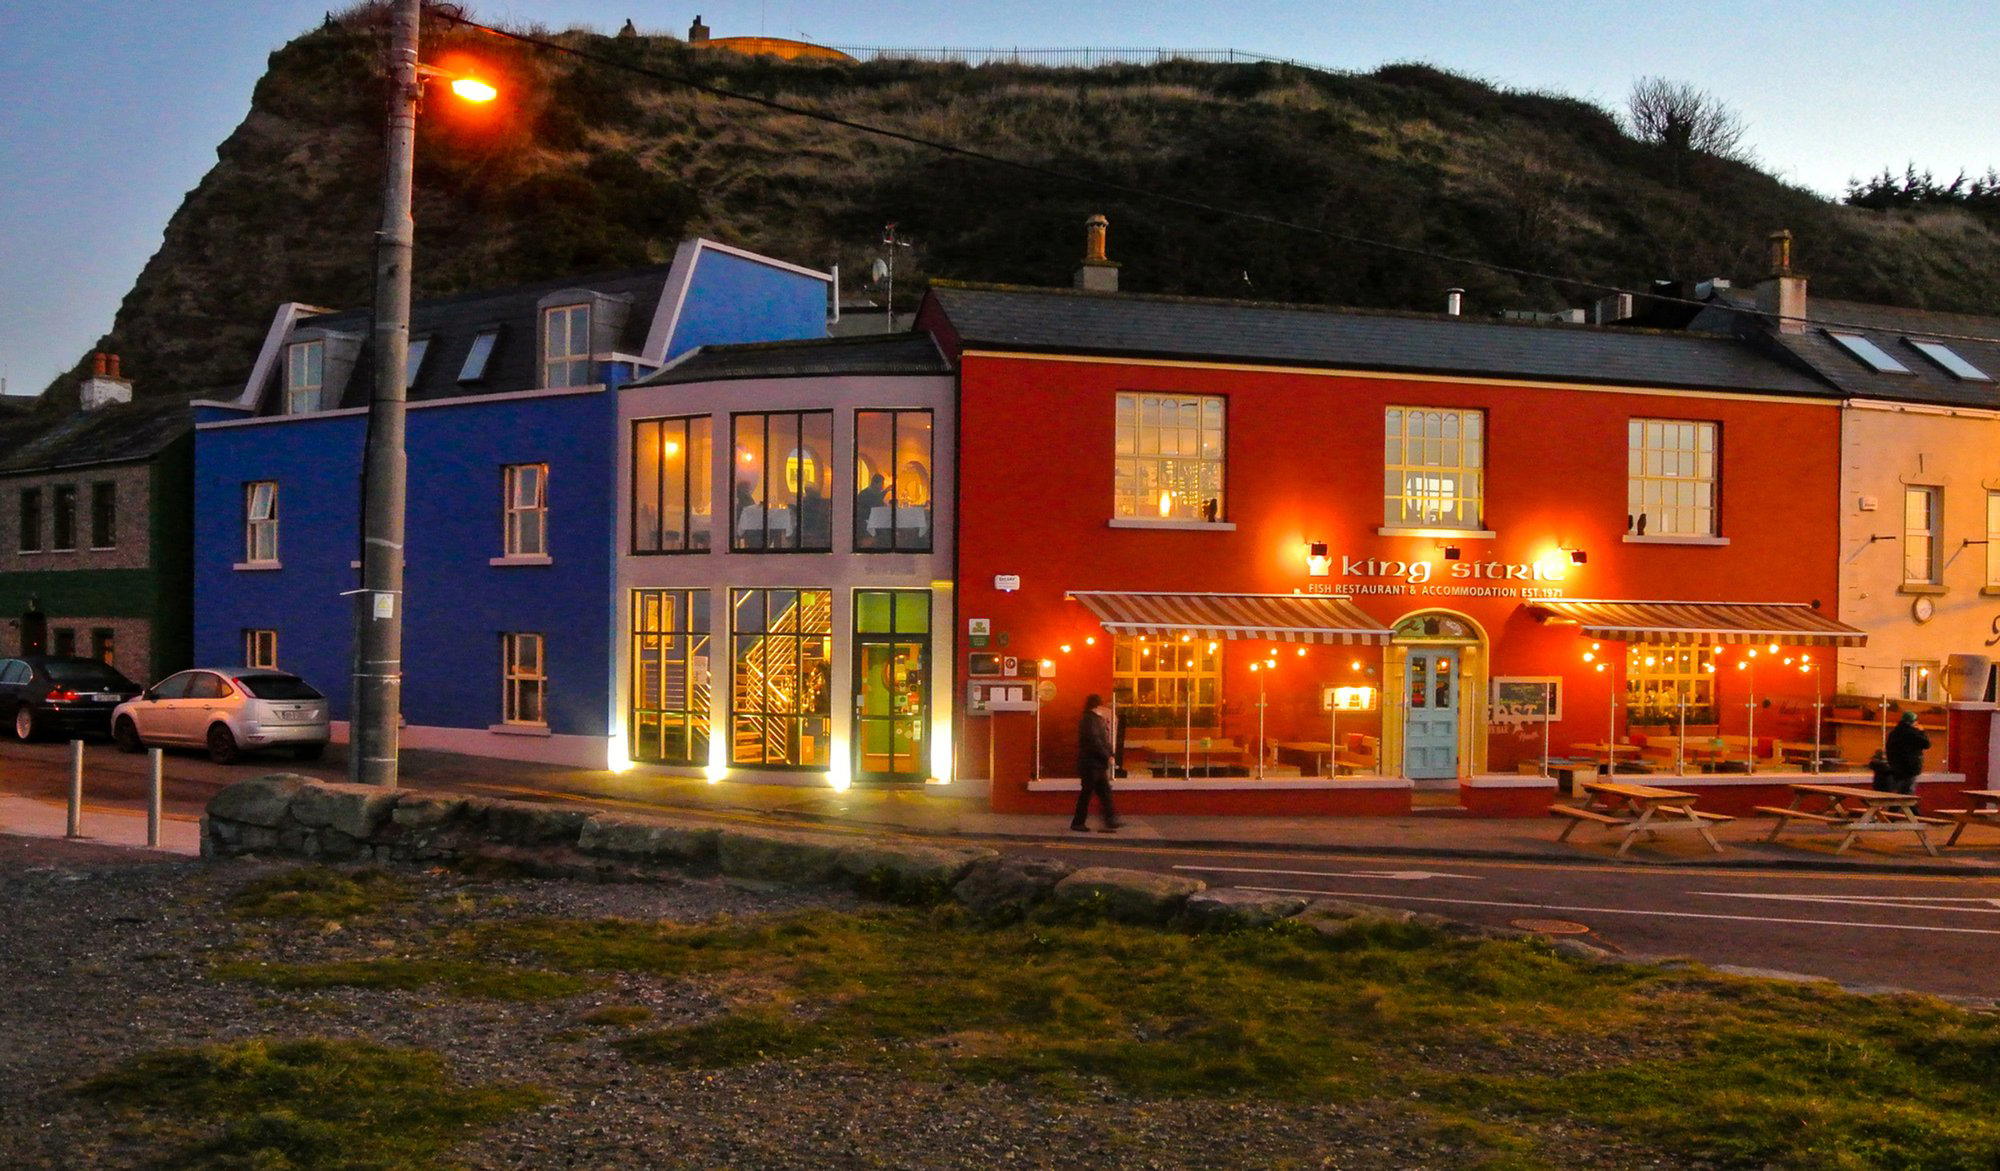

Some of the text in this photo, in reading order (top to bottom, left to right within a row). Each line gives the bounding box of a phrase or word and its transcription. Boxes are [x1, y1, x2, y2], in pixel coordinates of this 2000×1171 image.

[1308, 583, 1332, 593] FISH
[1335, 584, 1406, 595] RESTAURANT
[1409, 585, 1416, 595] &
[1421, 585, 1517, 597] ACCOMMODATION
